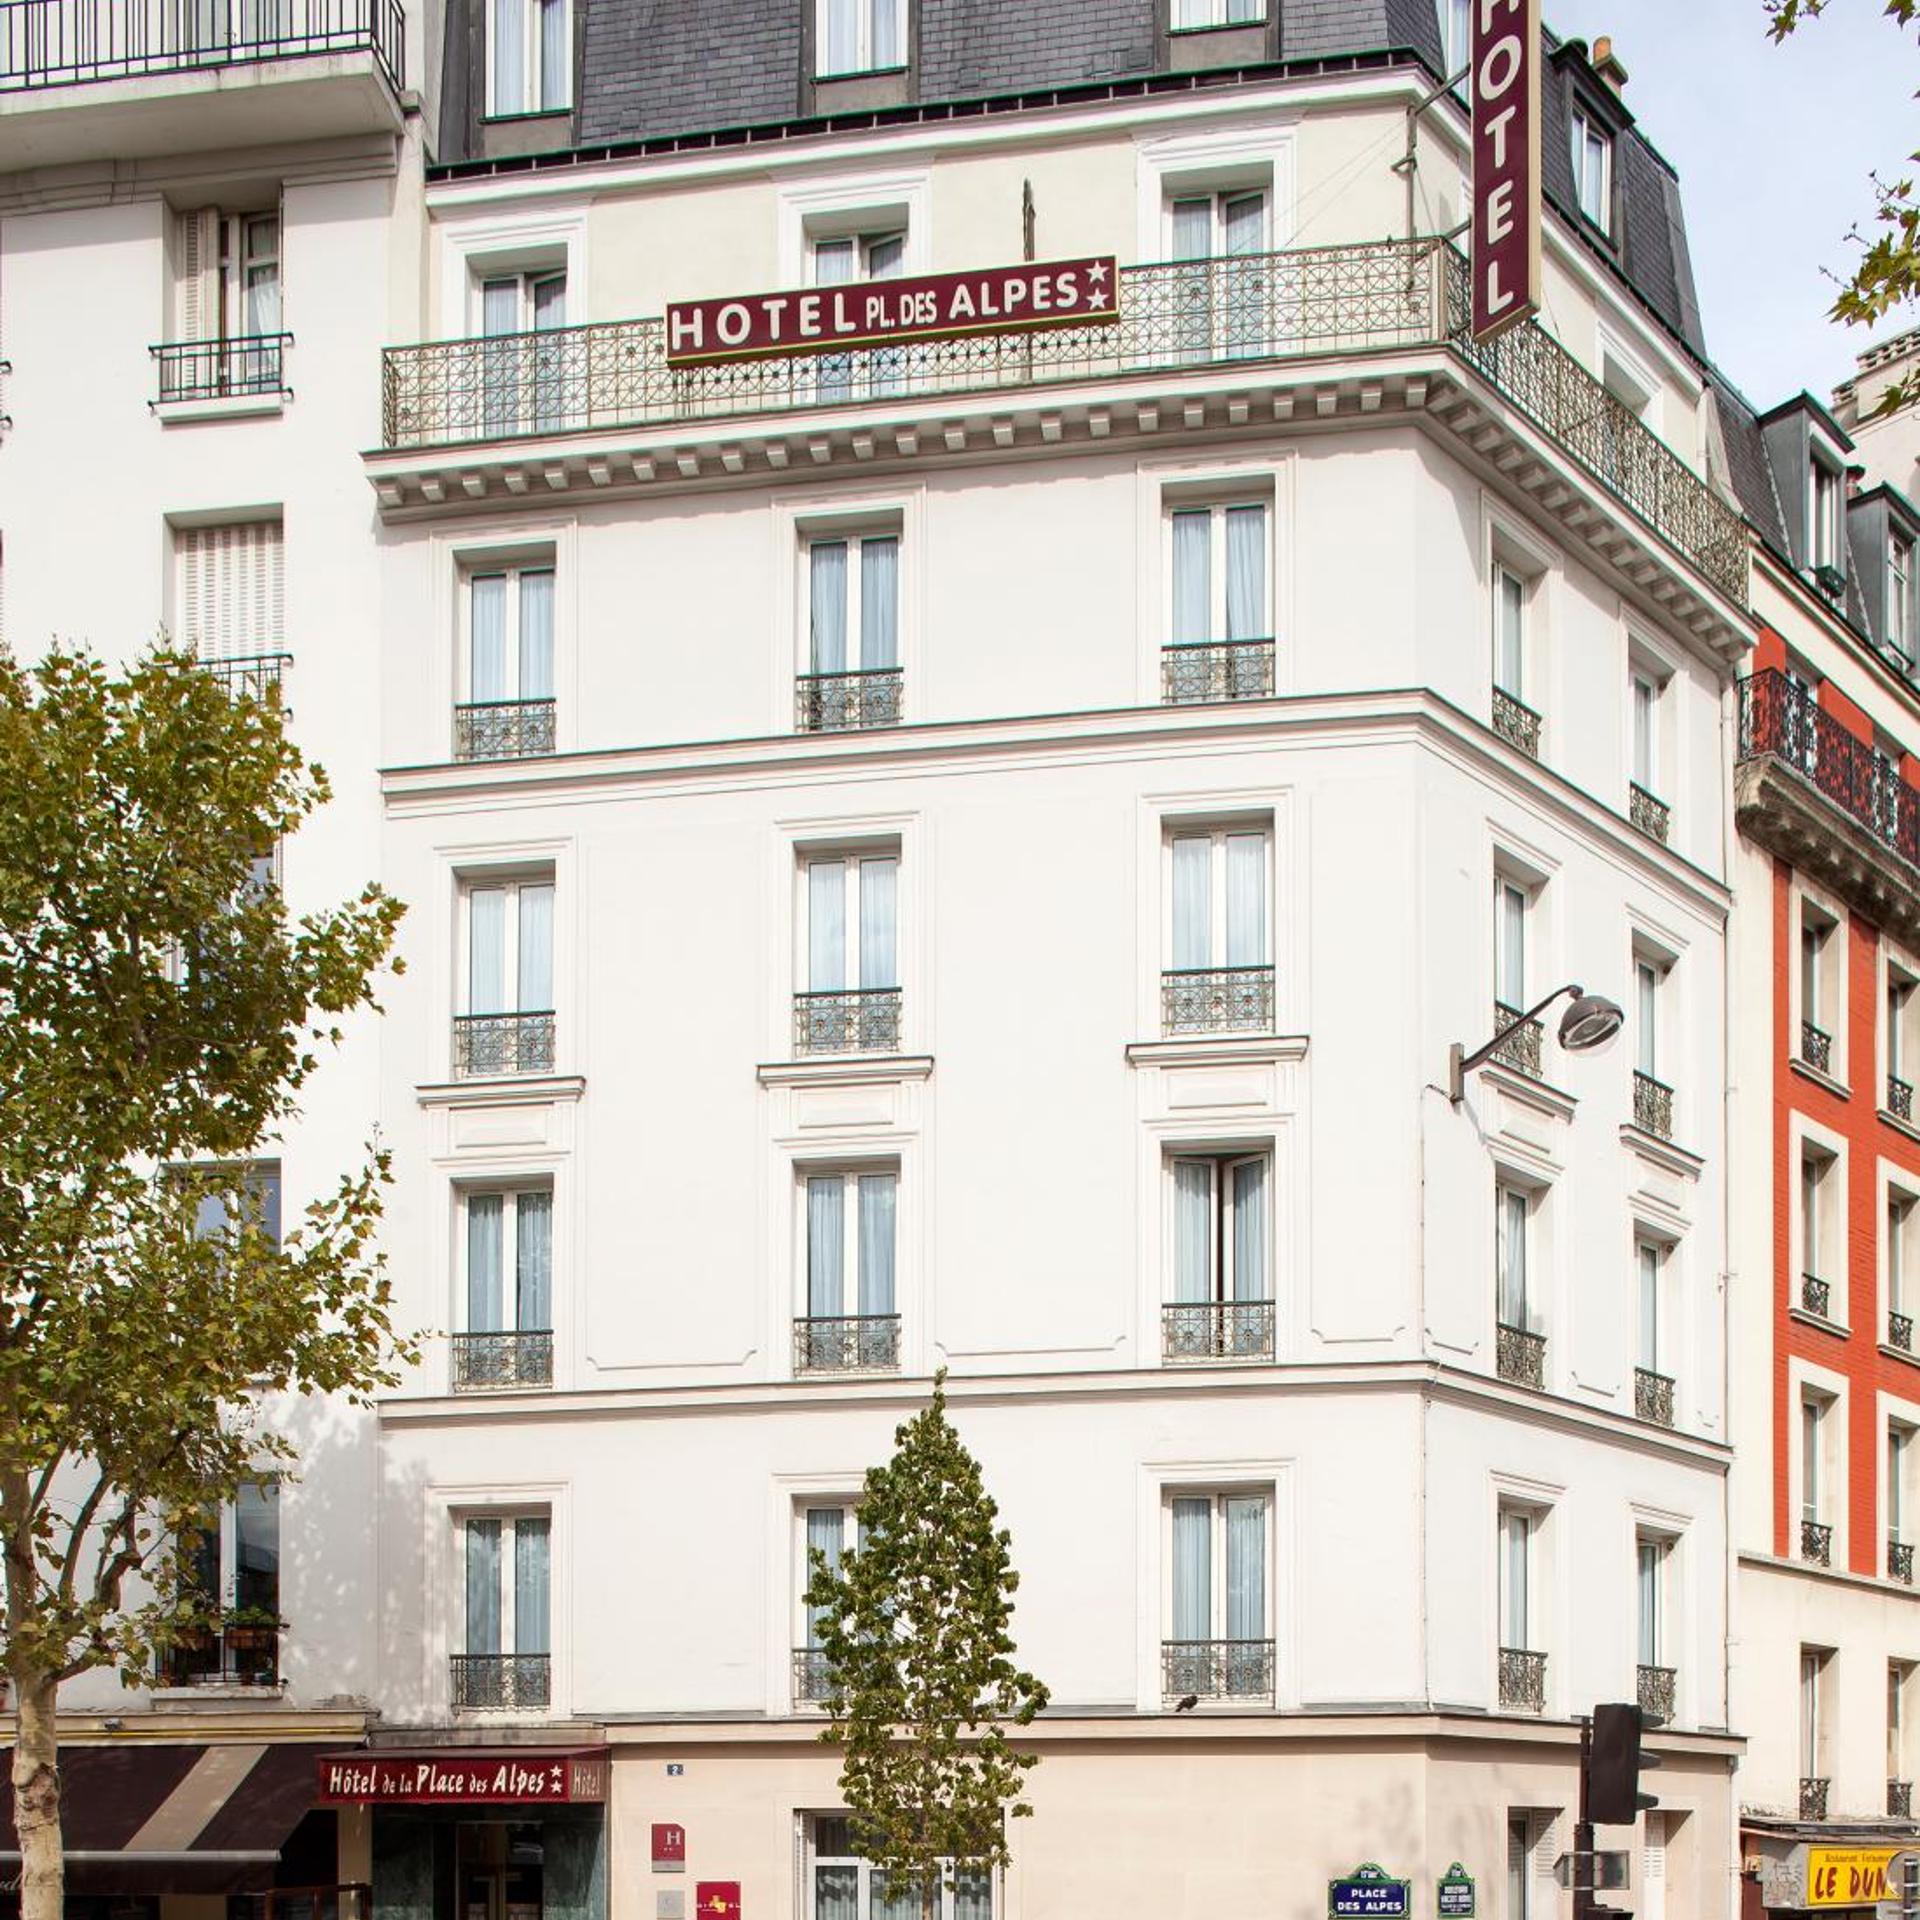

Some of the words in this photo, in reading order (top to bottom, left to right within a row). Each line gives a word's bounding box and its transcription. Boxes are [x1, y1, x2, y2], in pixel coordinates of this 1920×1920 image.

[671, 292, 857, 351] HOTEL
[866, 296, 896, 332] PL.
[900, 290, 938, 326] DES
[948, 271, 1080, 320] ALPES
[329, 1764, 377, 1794] Hôtel
[382, 1773, 396, 1794] de
[399, 1773, 413, 1793] la
[416, 1764, 465, 1794] Place
[469, 1773, 488, 1793] des
[492, 1763, 545, 1797] Alpes
[666, 1830, 681, 1845] H
[1351, 1888, 1388, 1898] PLACE
[1815, 1866, 1838, 1899] LE
[1337, 1902, 1361, 1911] DES
[1365, 1902, 1402, 1911] ALPES
